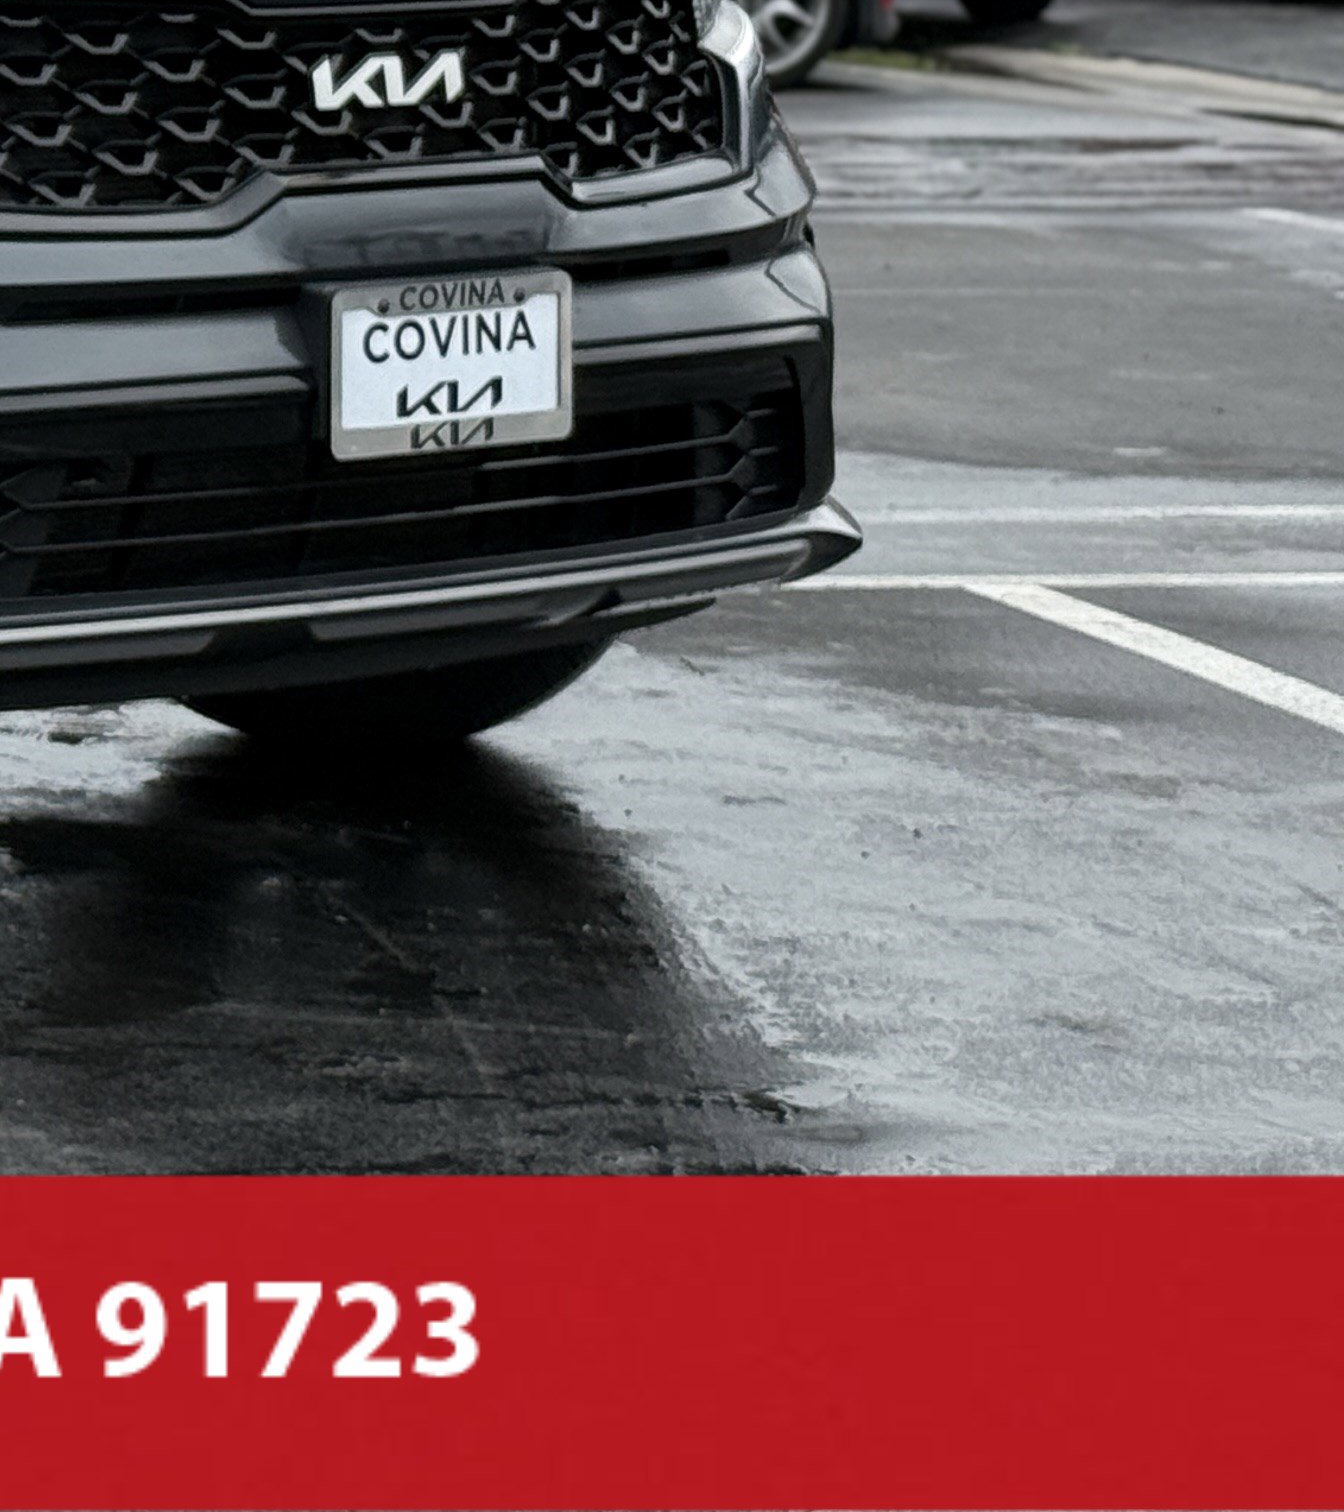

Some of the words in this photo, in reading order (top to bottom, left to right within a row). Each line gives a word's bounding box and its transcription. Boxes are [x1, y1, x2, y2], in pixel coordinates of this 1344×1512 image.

[312, 51, 463, 110] KIA
[399, 279, 505, 311] COVINA
[363, 309, 536, 363] COVINA
[396, 375, 503, 417] KIA
[410, 417, 494, 449] KIA
